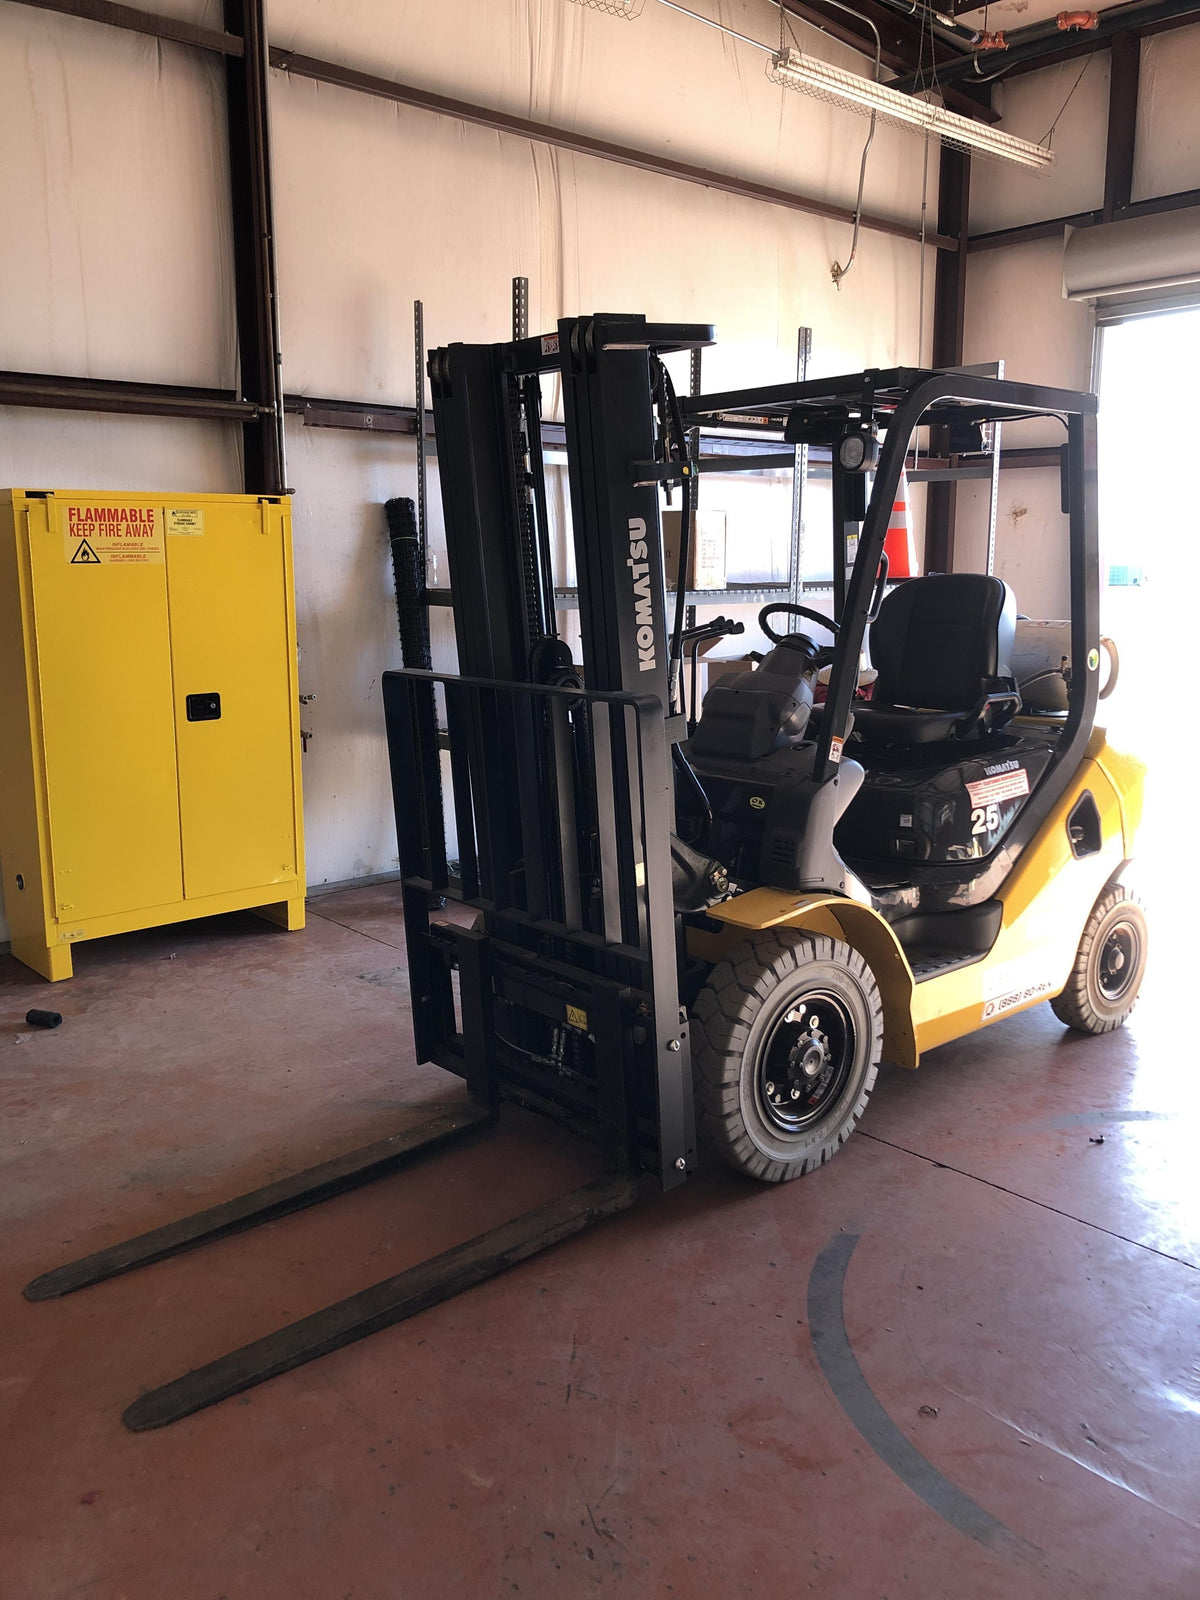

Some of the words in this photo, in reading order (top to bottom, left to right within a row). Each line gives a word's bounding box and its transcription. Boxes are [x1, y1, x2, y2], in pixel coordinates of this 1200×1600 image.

[68, 507, 154, 523] FLAMMABLE
[69, 523, 95, 537] KEEP
[99, 523, 122, 537] FIRE
[125, 524, 154, 538] AWAY
[627, 517, 656, 672] KOMATSU
[984, 760, 1019, 776] KOMATSU
[970, 804, 999, 835] 25
[998, 991, 1022, 1010] (888)
